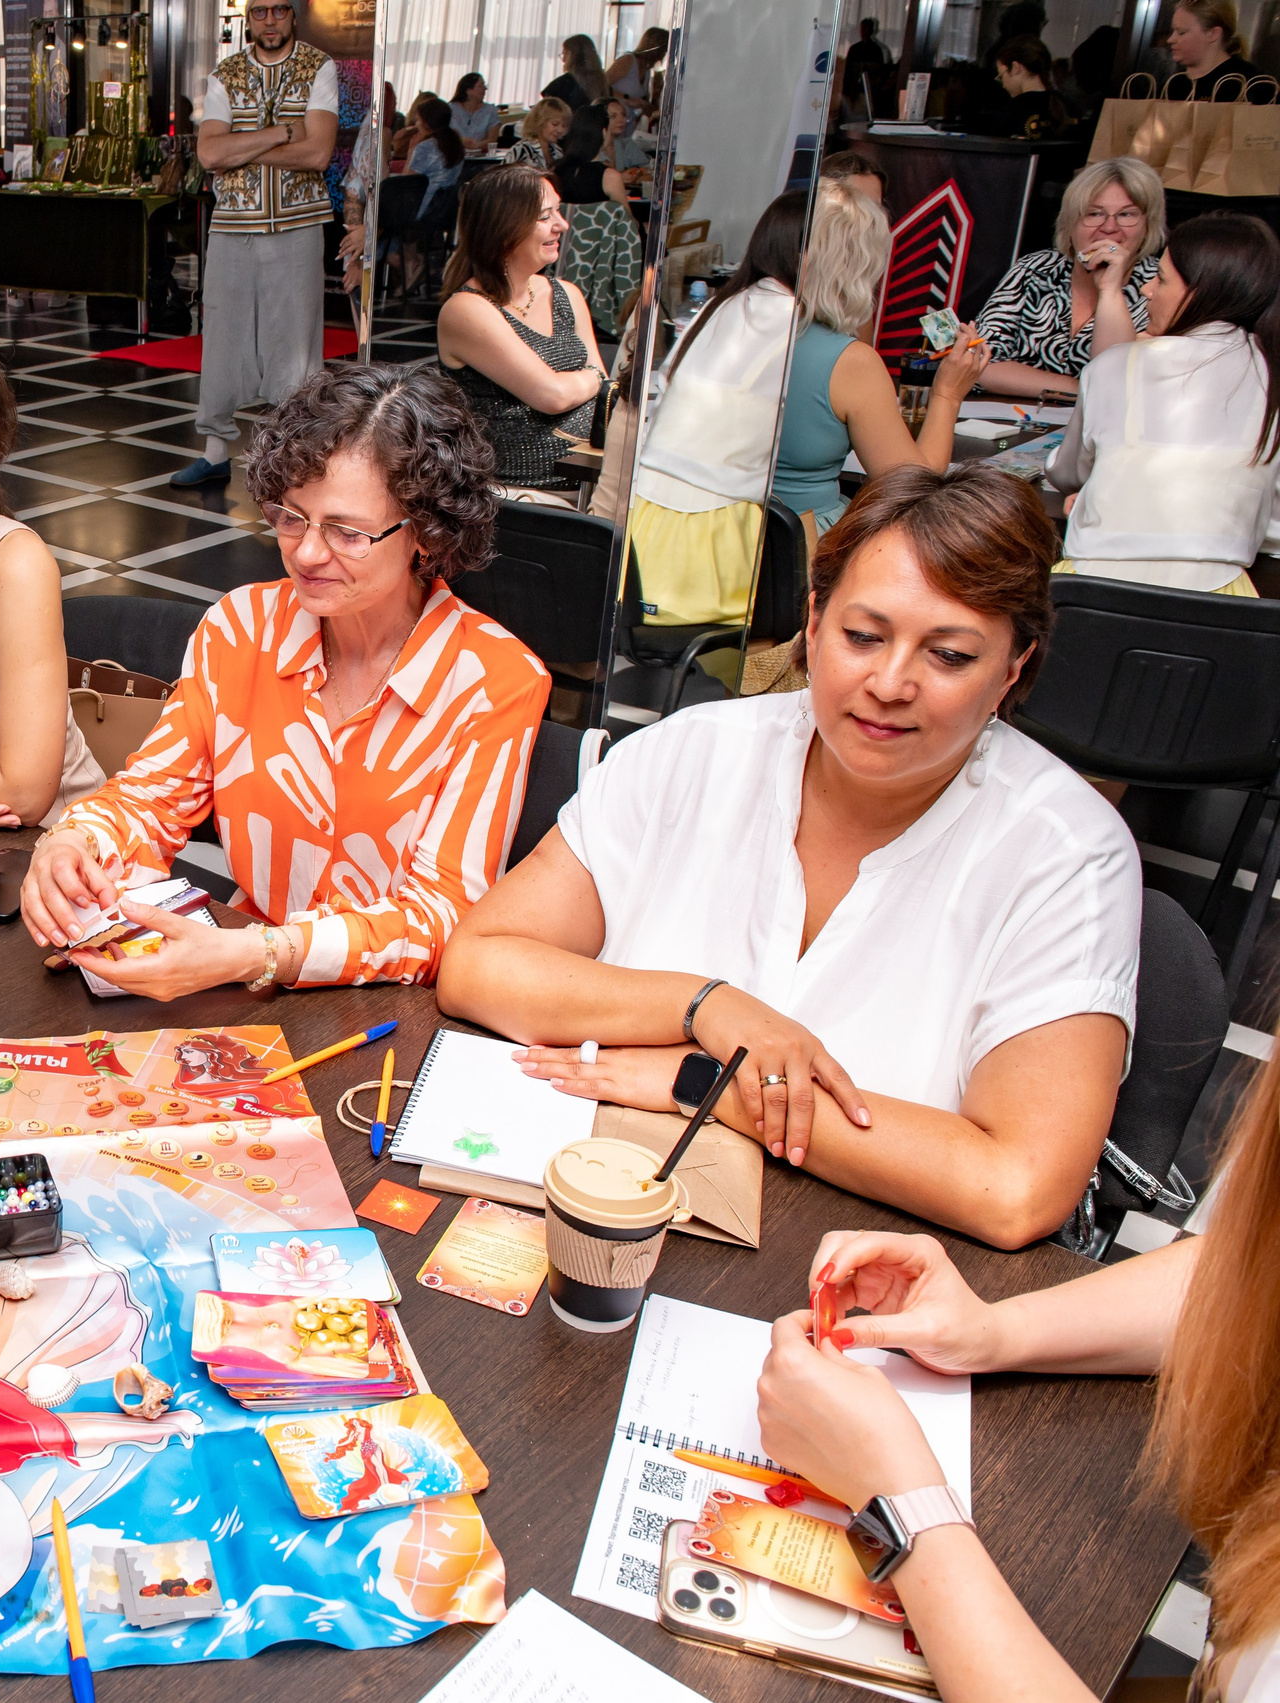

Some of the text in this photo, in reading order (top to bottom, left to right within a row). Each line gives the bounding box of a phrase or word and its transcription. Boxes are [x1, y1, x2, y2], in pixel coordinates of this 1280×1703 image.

[77, 1077, 107, 1088] СТАРТ
[154, 1086, 213, 1105] Нить Творить
[99, 1149, 181, 1176] Нить Чувствовать
[277, 1206, 312, 1215] СТАРТ
